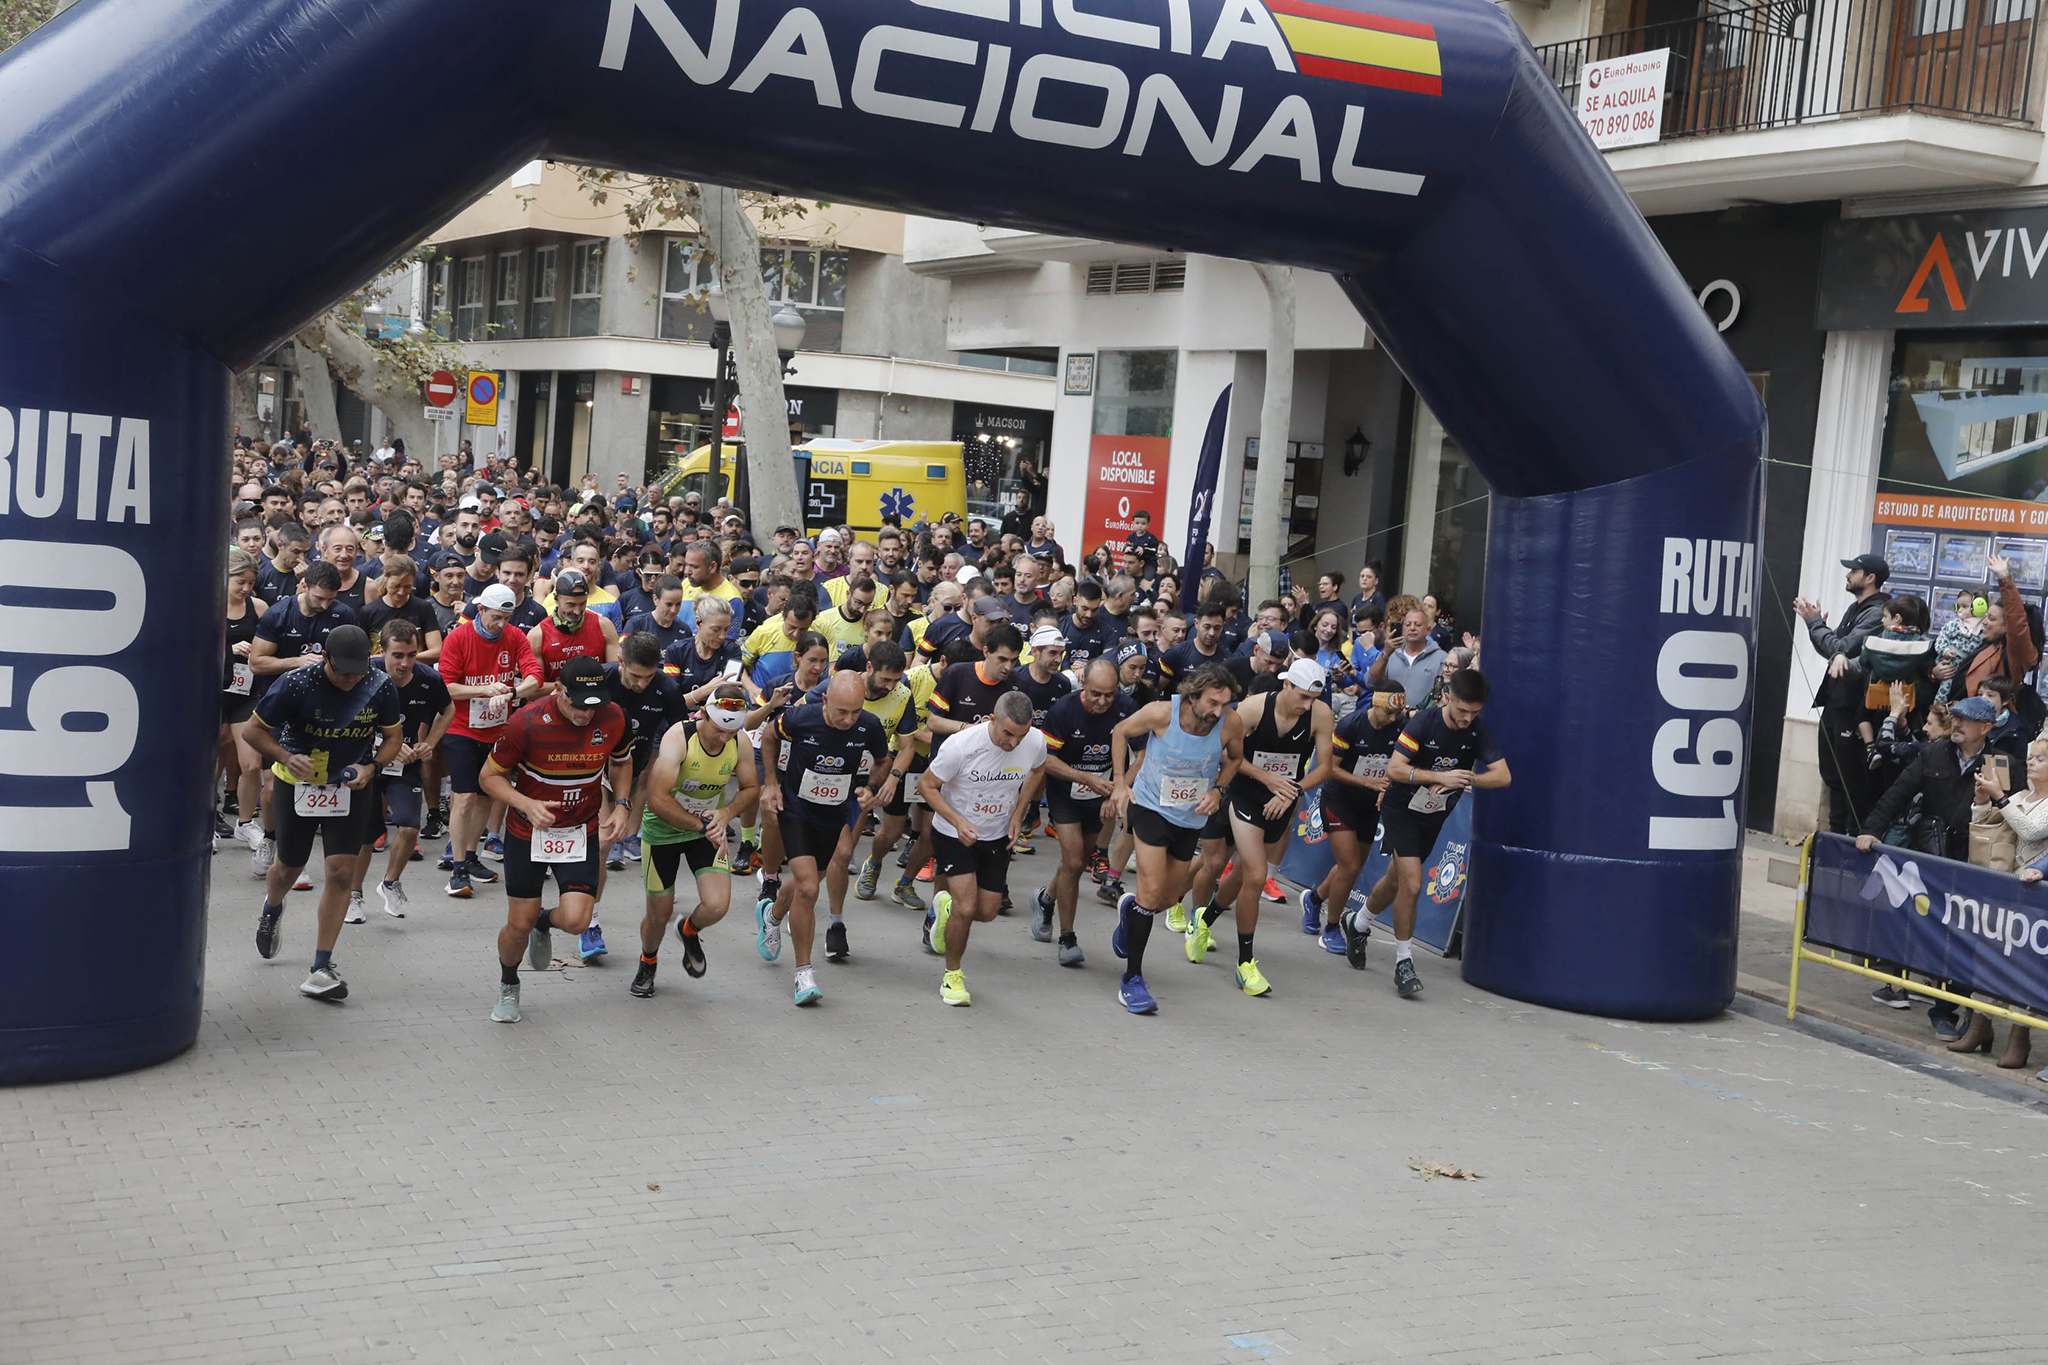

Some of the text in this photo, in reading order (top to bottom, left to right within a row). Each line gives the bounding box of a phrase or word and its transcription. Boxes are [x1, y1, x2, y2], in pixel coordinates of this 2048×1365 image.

[598, 0, 1426, 197] NACIONAL
[1585, 85, 1657, 113] SE ALQUILA
[1606, 113, 1630, 135] 890
[1632, 109, 1655, 132] 086
[986, 416, 1027, 430] MACSON
[1112, 450, 1143, 467] LOCAL
[1100, 466, 1156, 485] DISPONIBLE
[1878, 501, 1919, 518] ESTUDIO
[1921, 504, 1935, 518] DE
[1937, 505, 2016, 524] ARQUITECTURA
[2020, 509, 2028, 524] Y
[1660, 537, 1755, 619] RUTA
[465, 674, 496, 686] NUCLEO
[1648, 629, 1749, 850] 091
[548, 753, 605, 762] KAMIKAZES
[1262, 763, 1289, 773] 555
[1363, 768, 1386, 779] 319
[810, 785, 839, 799] 499
[1171, 788, 1197, 800] 562
[307, 794, 339, 808] 324
[973, 802, 1003, 814] 3401
[543, 840, 576, 854] 387
